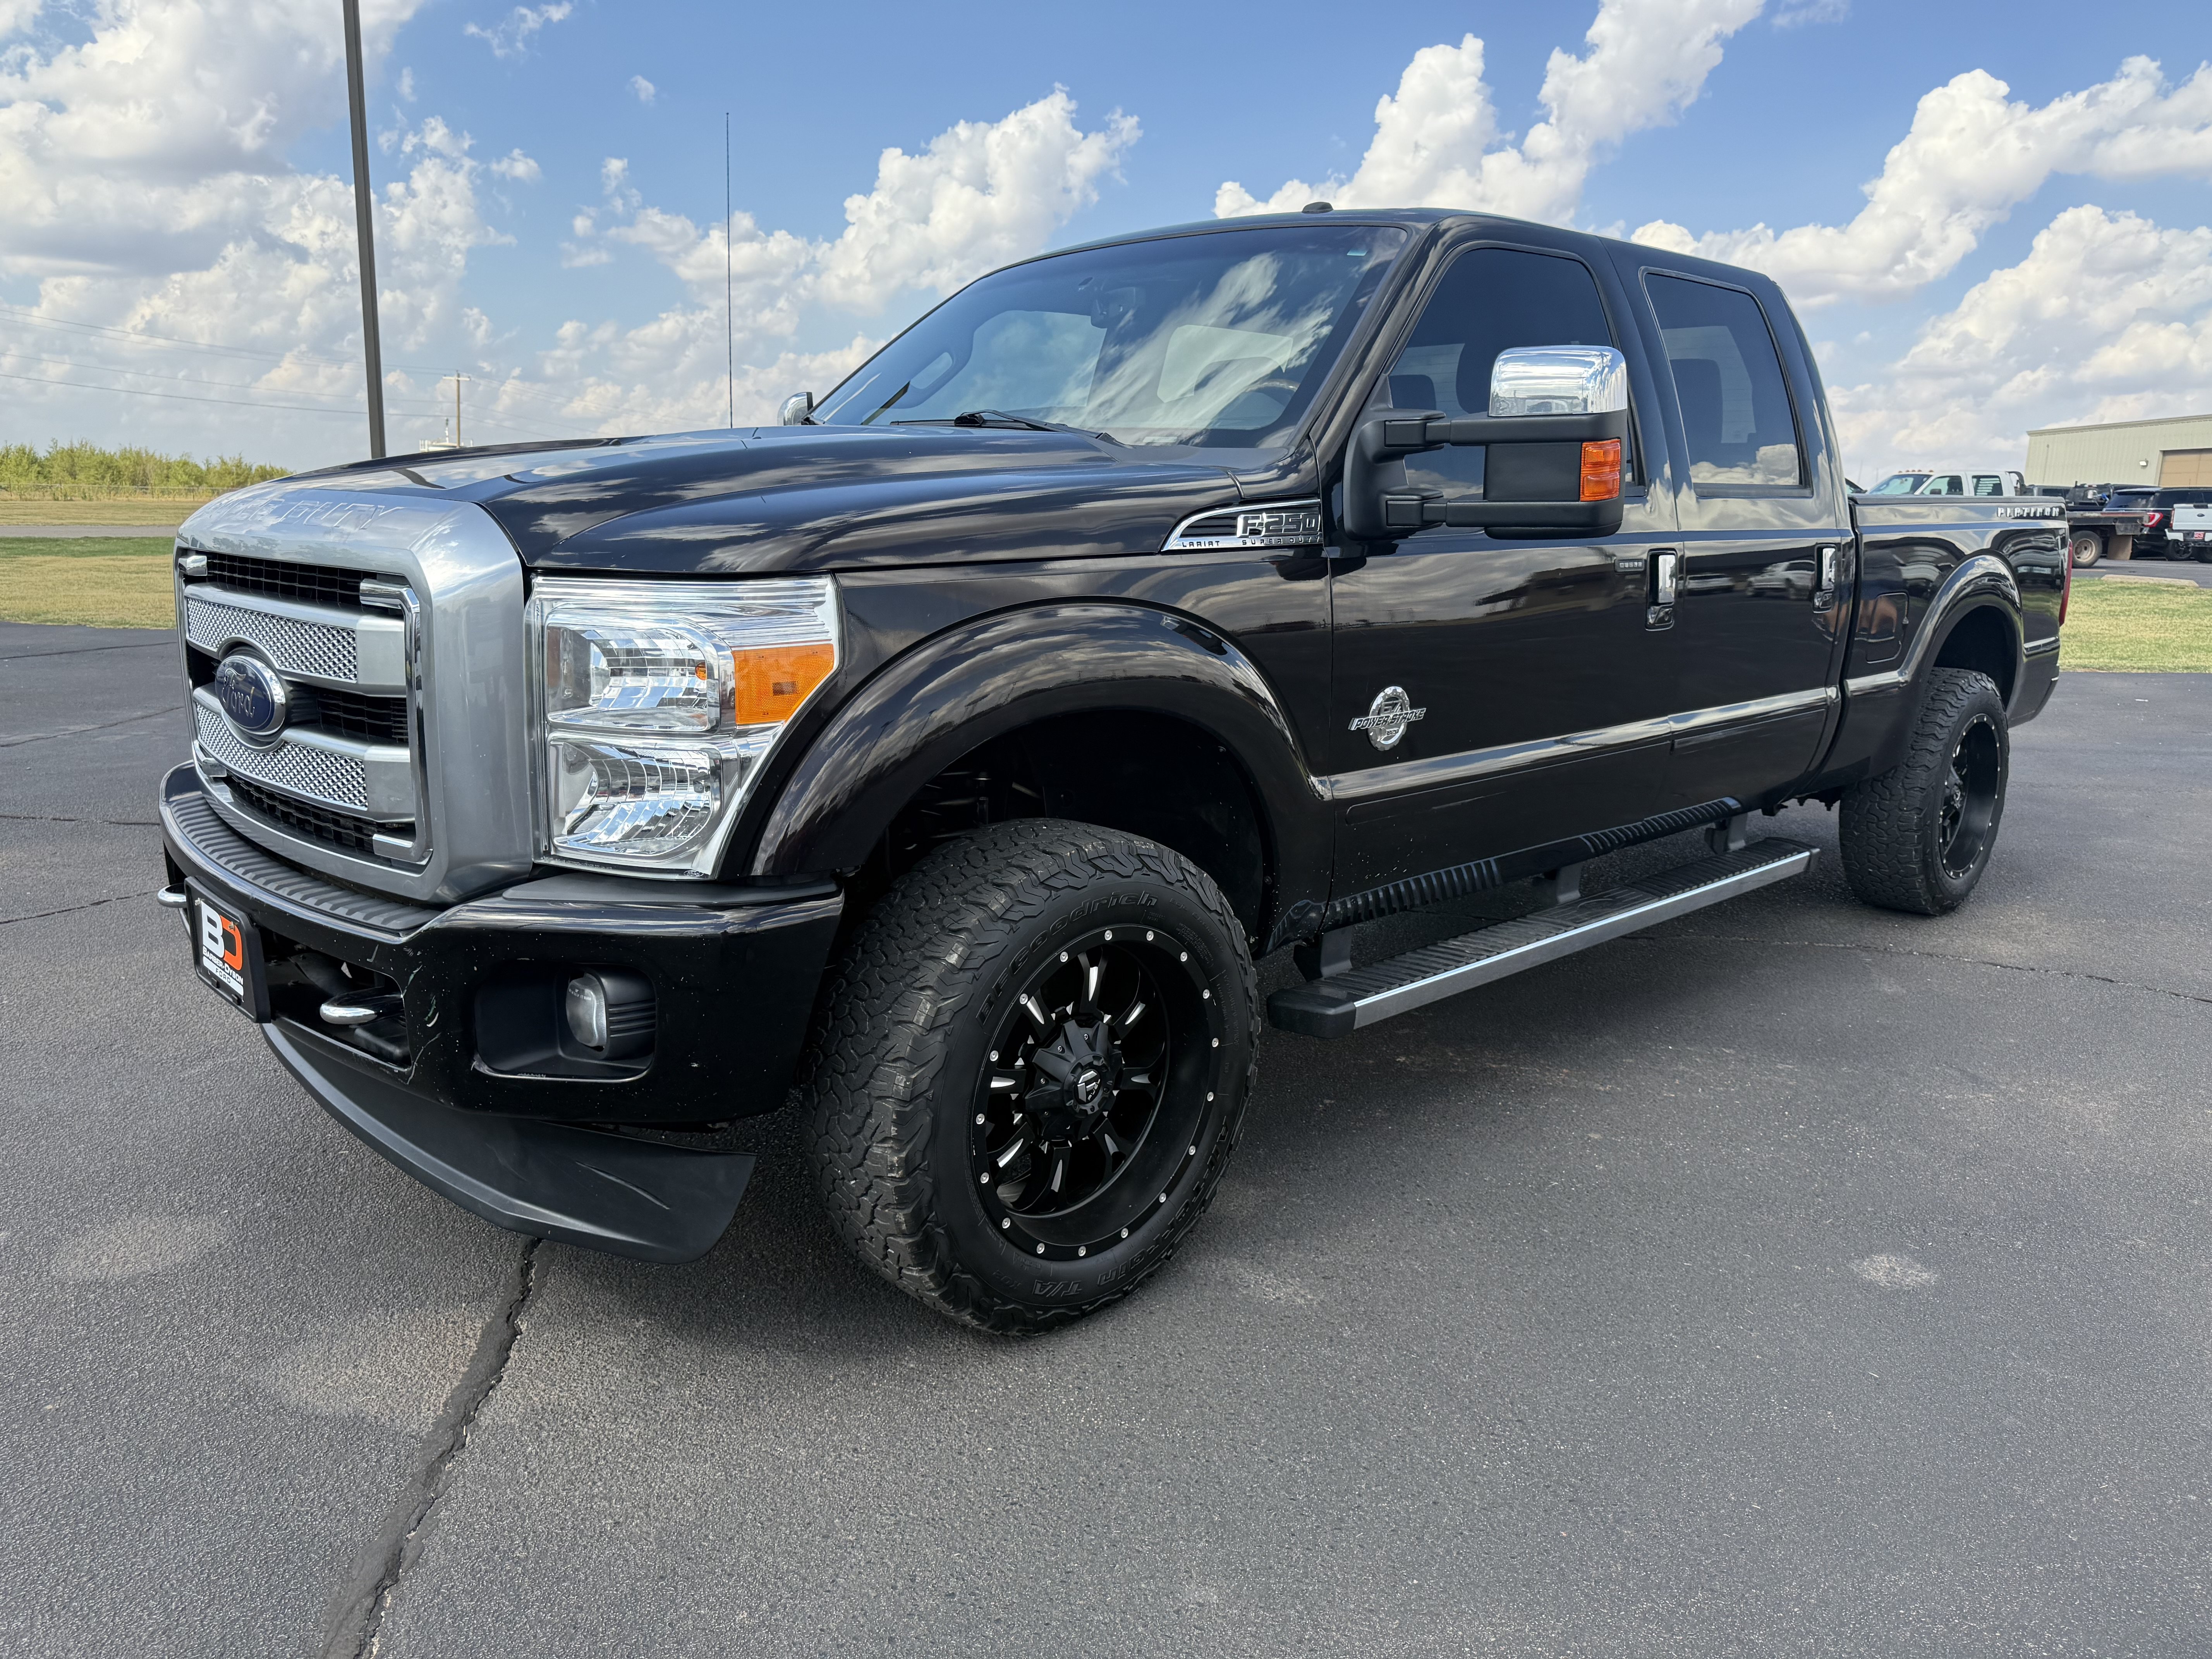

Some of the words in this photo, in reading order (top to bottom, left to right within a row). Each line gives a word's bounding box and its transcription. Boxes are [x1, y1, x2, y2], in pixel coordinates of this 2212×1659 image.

[279, 500, 407, 530] DUTY
[1238, 514, 1321, 536] F-250
[222, 667, 256, 718] Ford
[976, 891, 1159, 1026] BFGoodrich
[216, 968, 231, 984] FORD
[1031, 1279, 1083, 1298] T/A
